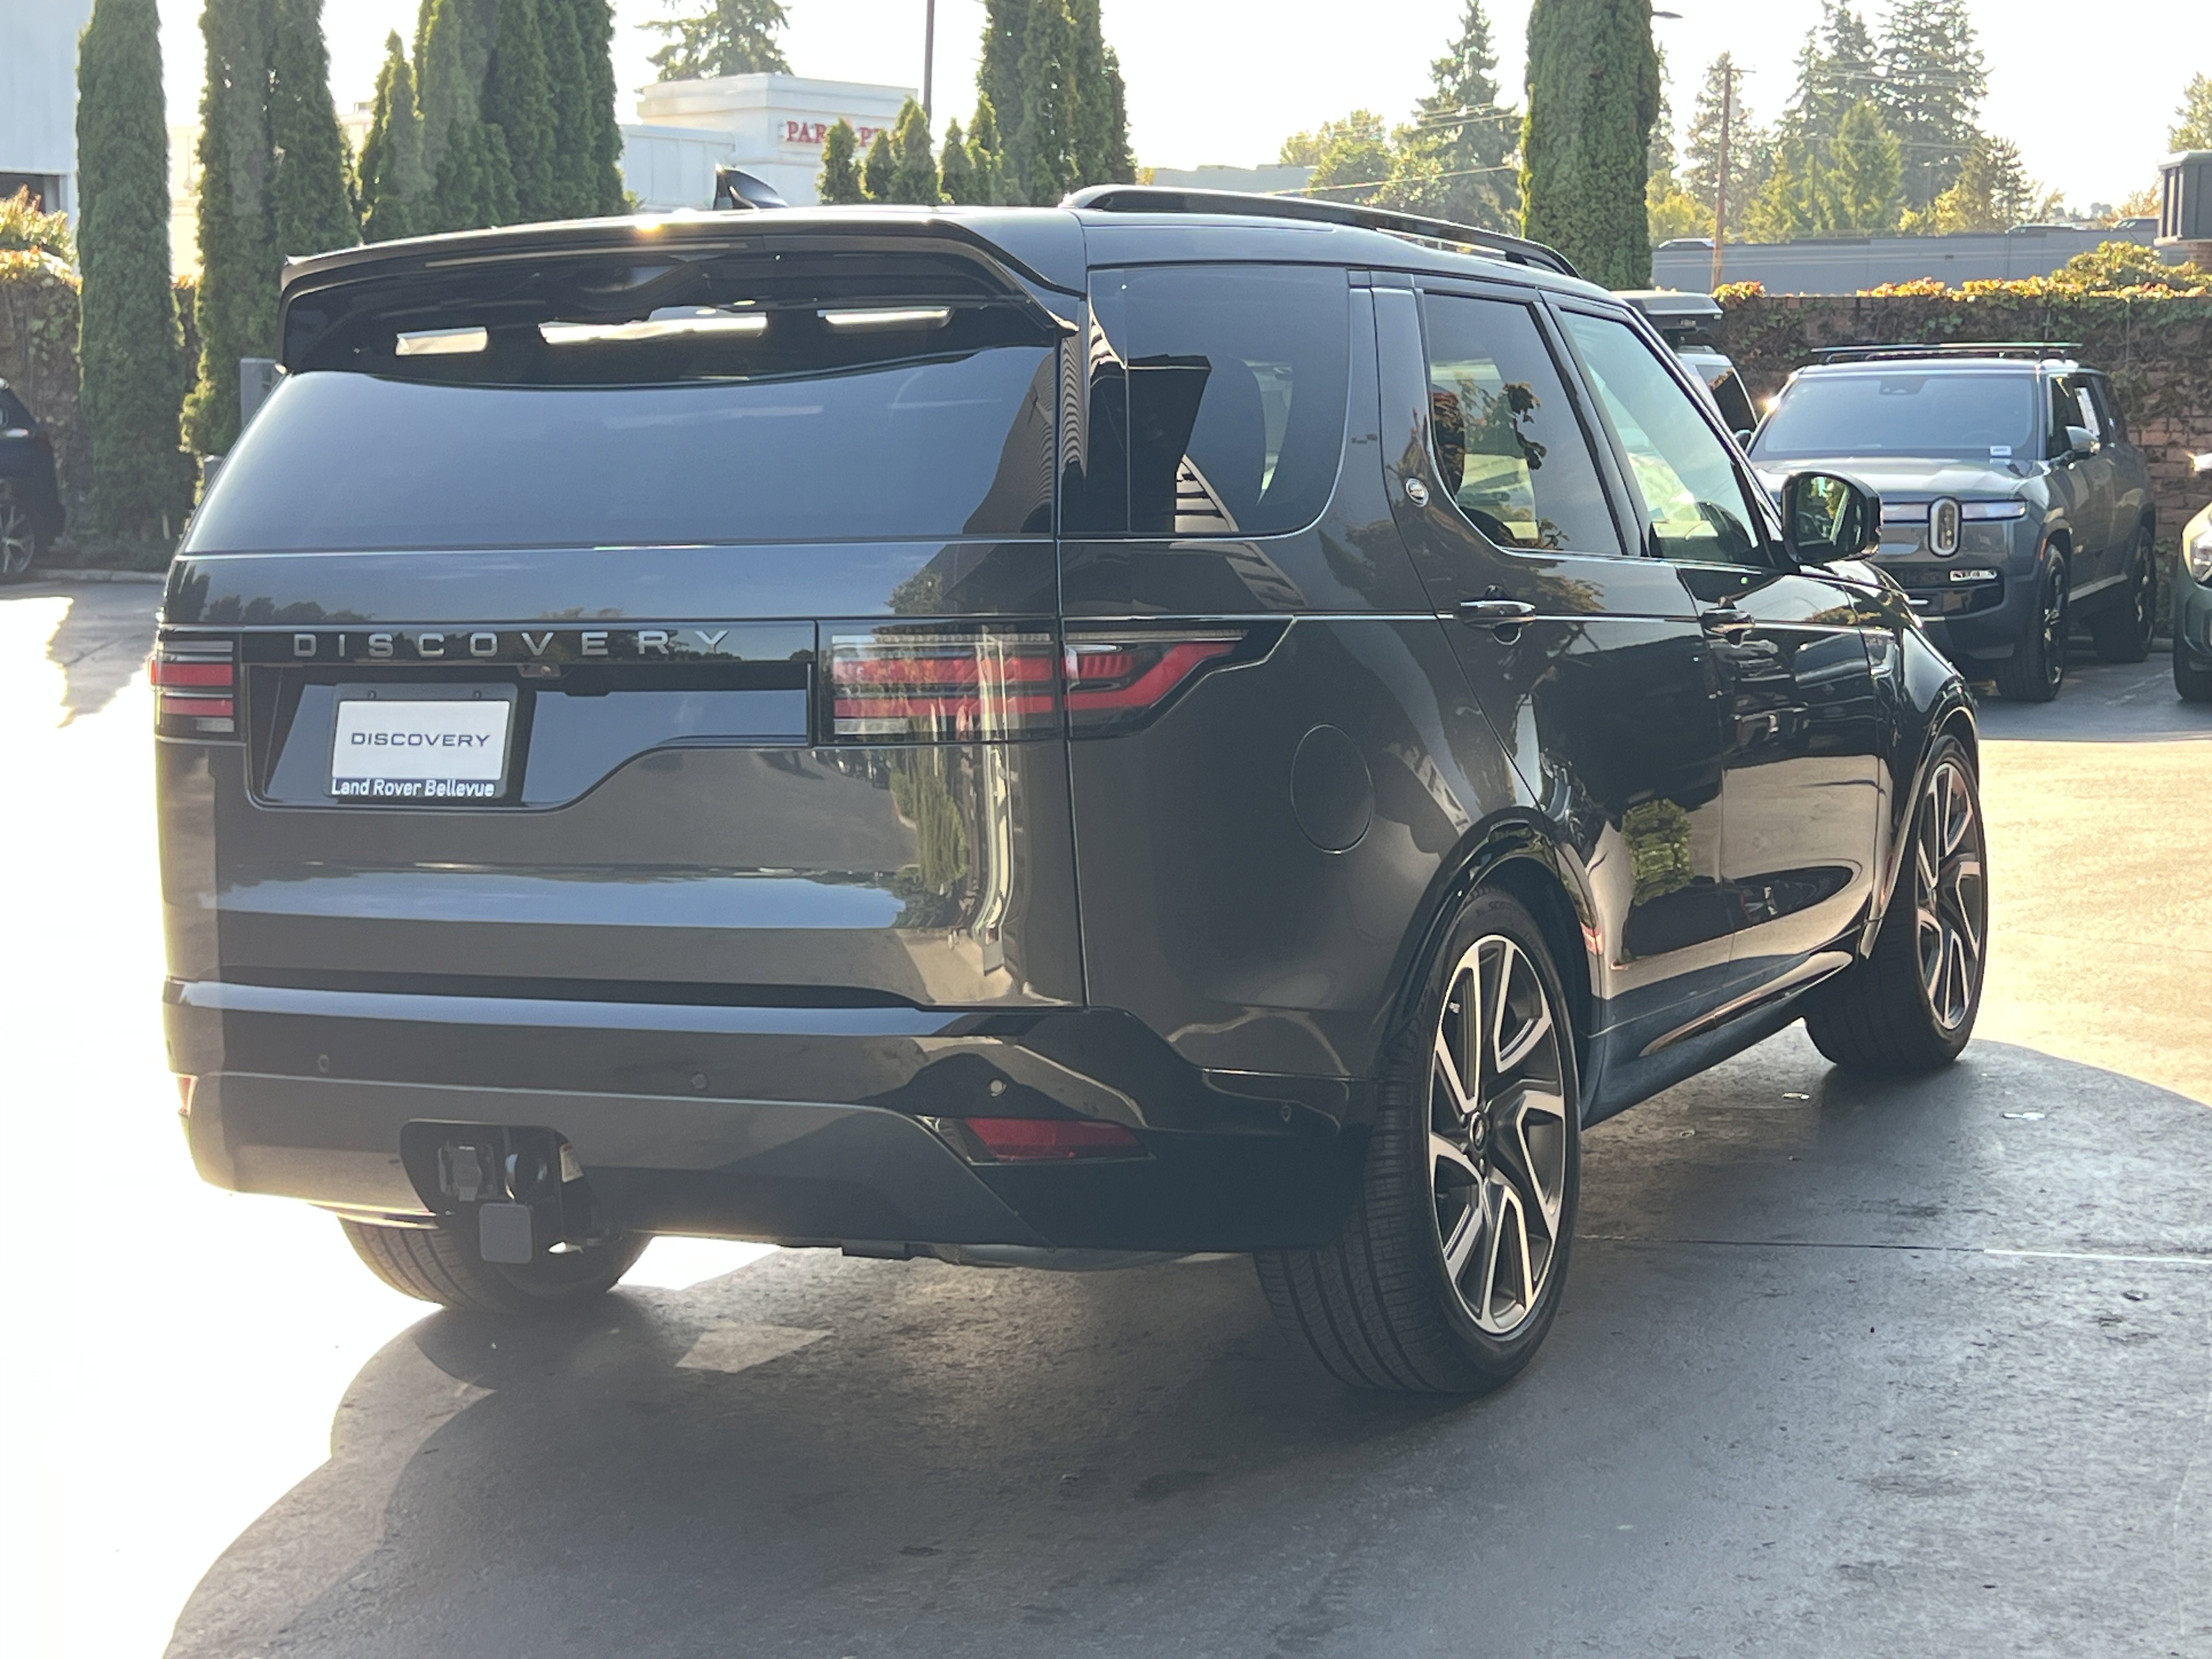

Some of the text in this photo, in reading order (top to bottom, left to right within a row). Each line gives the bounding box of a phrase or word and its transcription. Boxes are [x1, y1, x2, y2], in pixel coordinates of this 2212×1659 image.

[294, 630, 730, 657] DISCOVERY
[351, 732, 491, 747] DISCOVERY
[331, 777, 495, 797] Land Rover Bellevue
